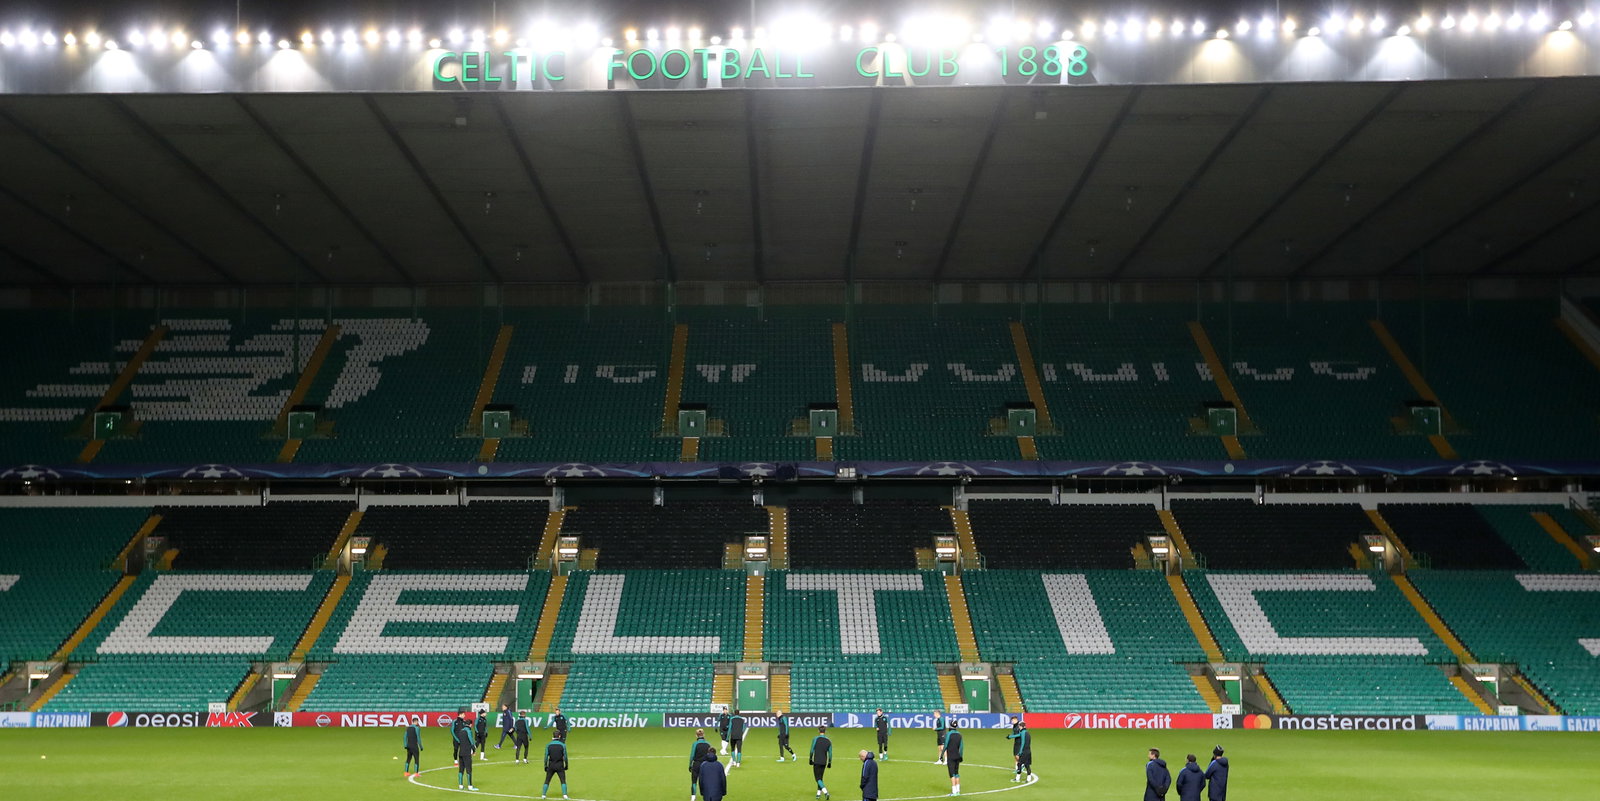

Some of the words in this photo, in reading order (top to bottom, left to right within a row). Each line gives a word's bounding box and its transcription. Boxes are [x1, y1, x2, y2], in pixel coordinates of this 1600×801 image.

[432, 51, 565, 83] CELTIC
[607, 47, 815, 81] FOOTBALL
[855, 46, 960, 78] CLUB
[997, 44, 1089, 77] 1888
[96, 573, 1428, 656] CELTIC
[36, 714, 88, 727] GAZPROM
[135, 711, 199, 727] pepsi
[205, 711, 258, 727] MAX
[341, 713, 427, 727] NISSAN
[668, 716, 700, 727] UEFA
[781, 716, 828, 728] EAGUE
[1085, 713, 1172, 729] UniCredit
[1278, 714, 1416, 730] mastercard
[1464, 717, 1520, 731] GAZPROM
